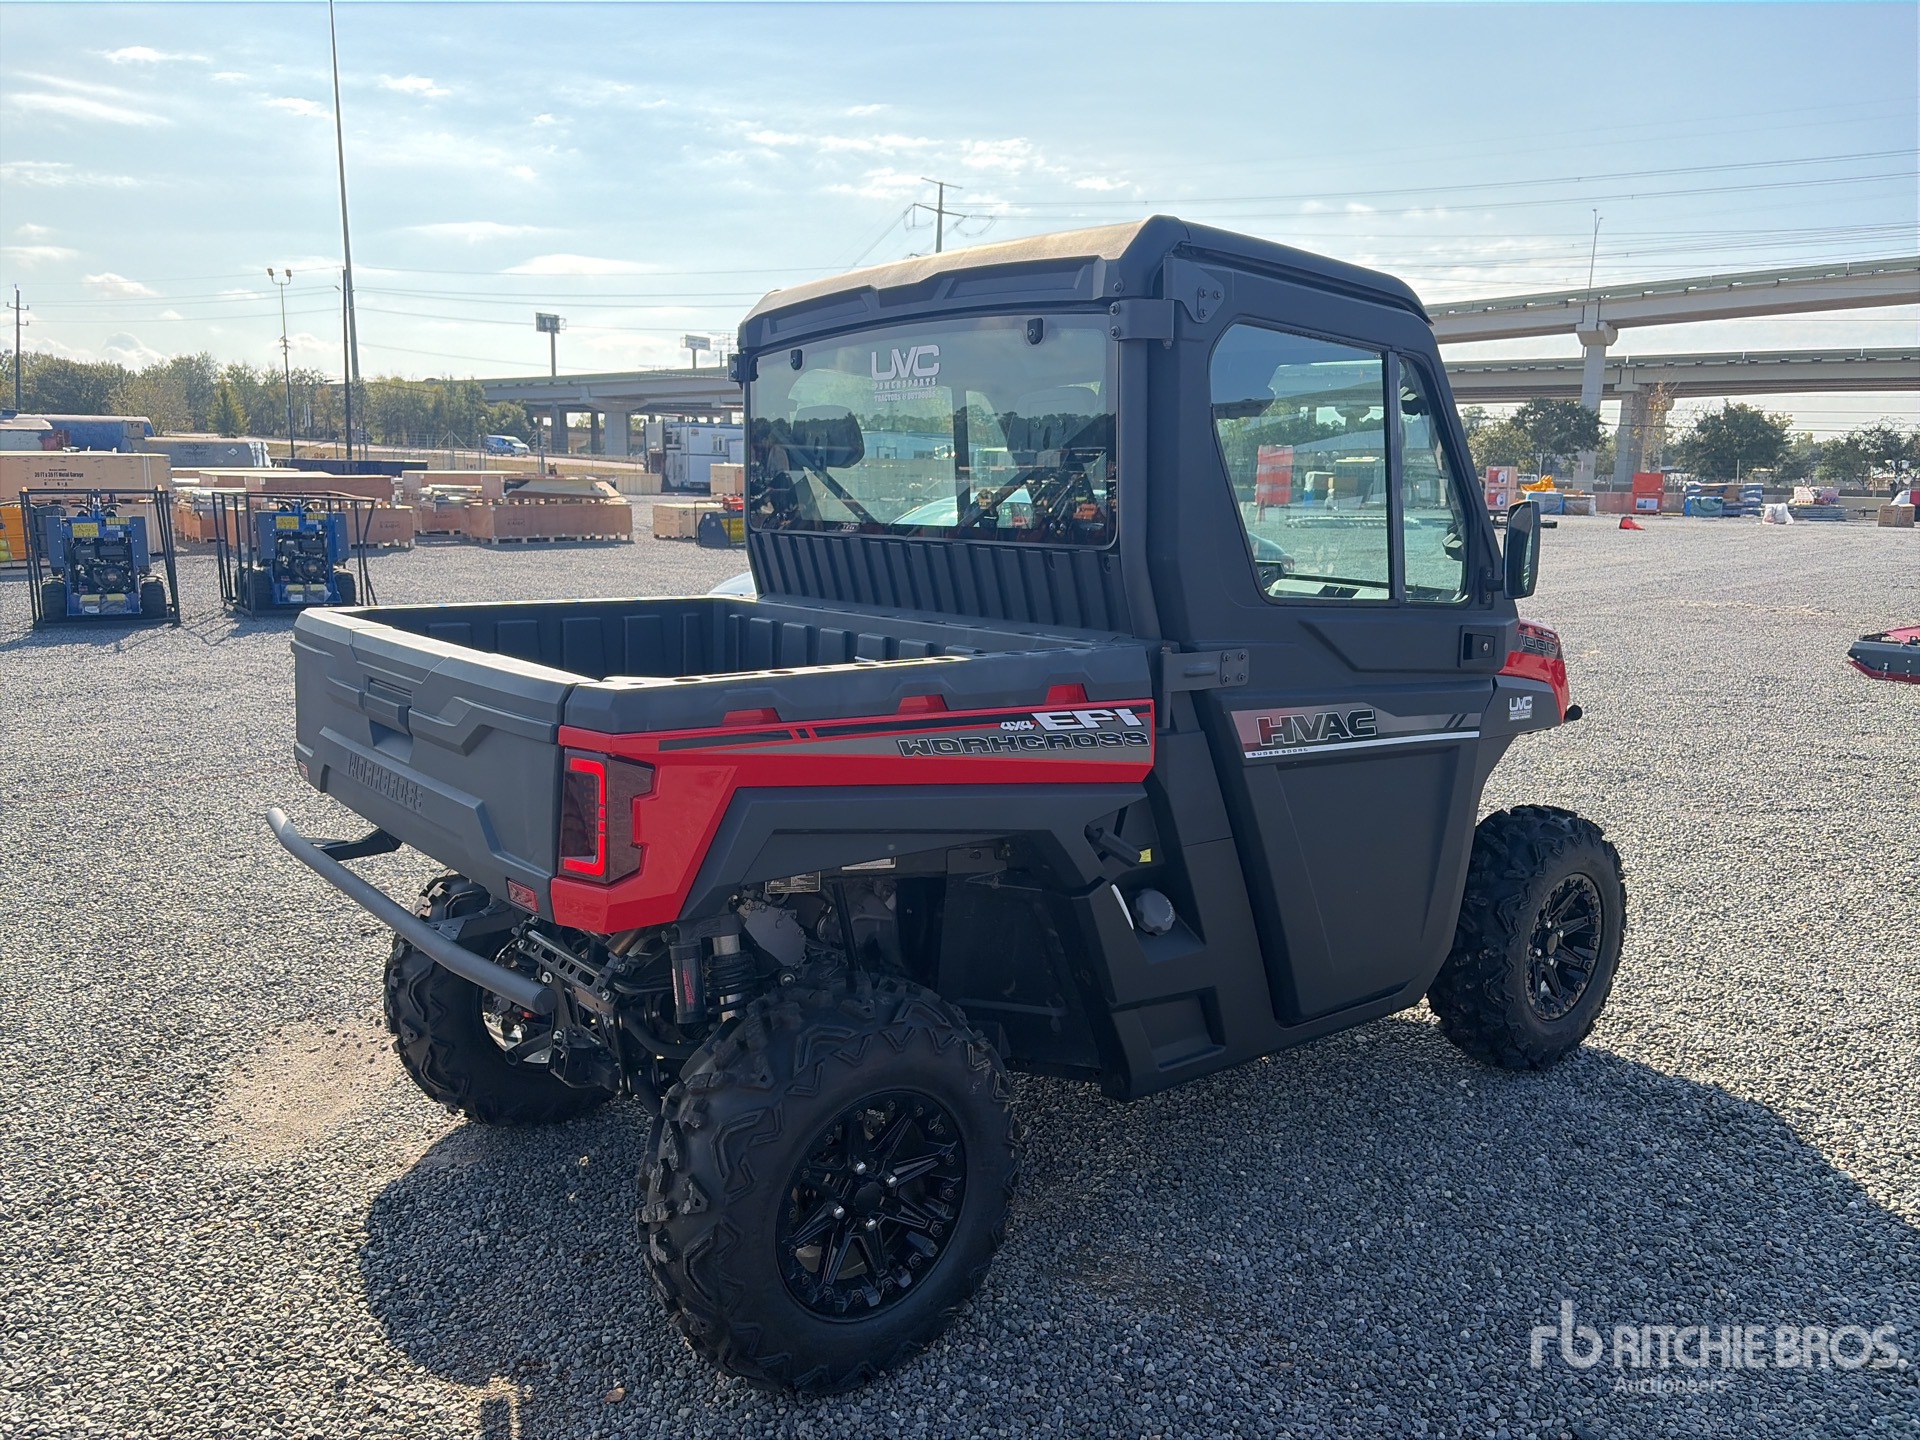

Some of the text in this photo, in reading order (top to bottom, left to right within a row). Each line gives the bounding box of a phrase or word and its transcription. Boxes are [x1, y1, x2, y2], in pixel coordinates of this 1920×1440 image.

[873, 377, 937, 390] POWERSPORTS
[875, 394, 901, 402] TRACTORS
[70, 471, 84, 479] Garage
[1031, 708, 1143, 731] EFI
[1256, 708, 1377, 746] HVAC
[897, 730, 1150, 757] WORKCROSS
